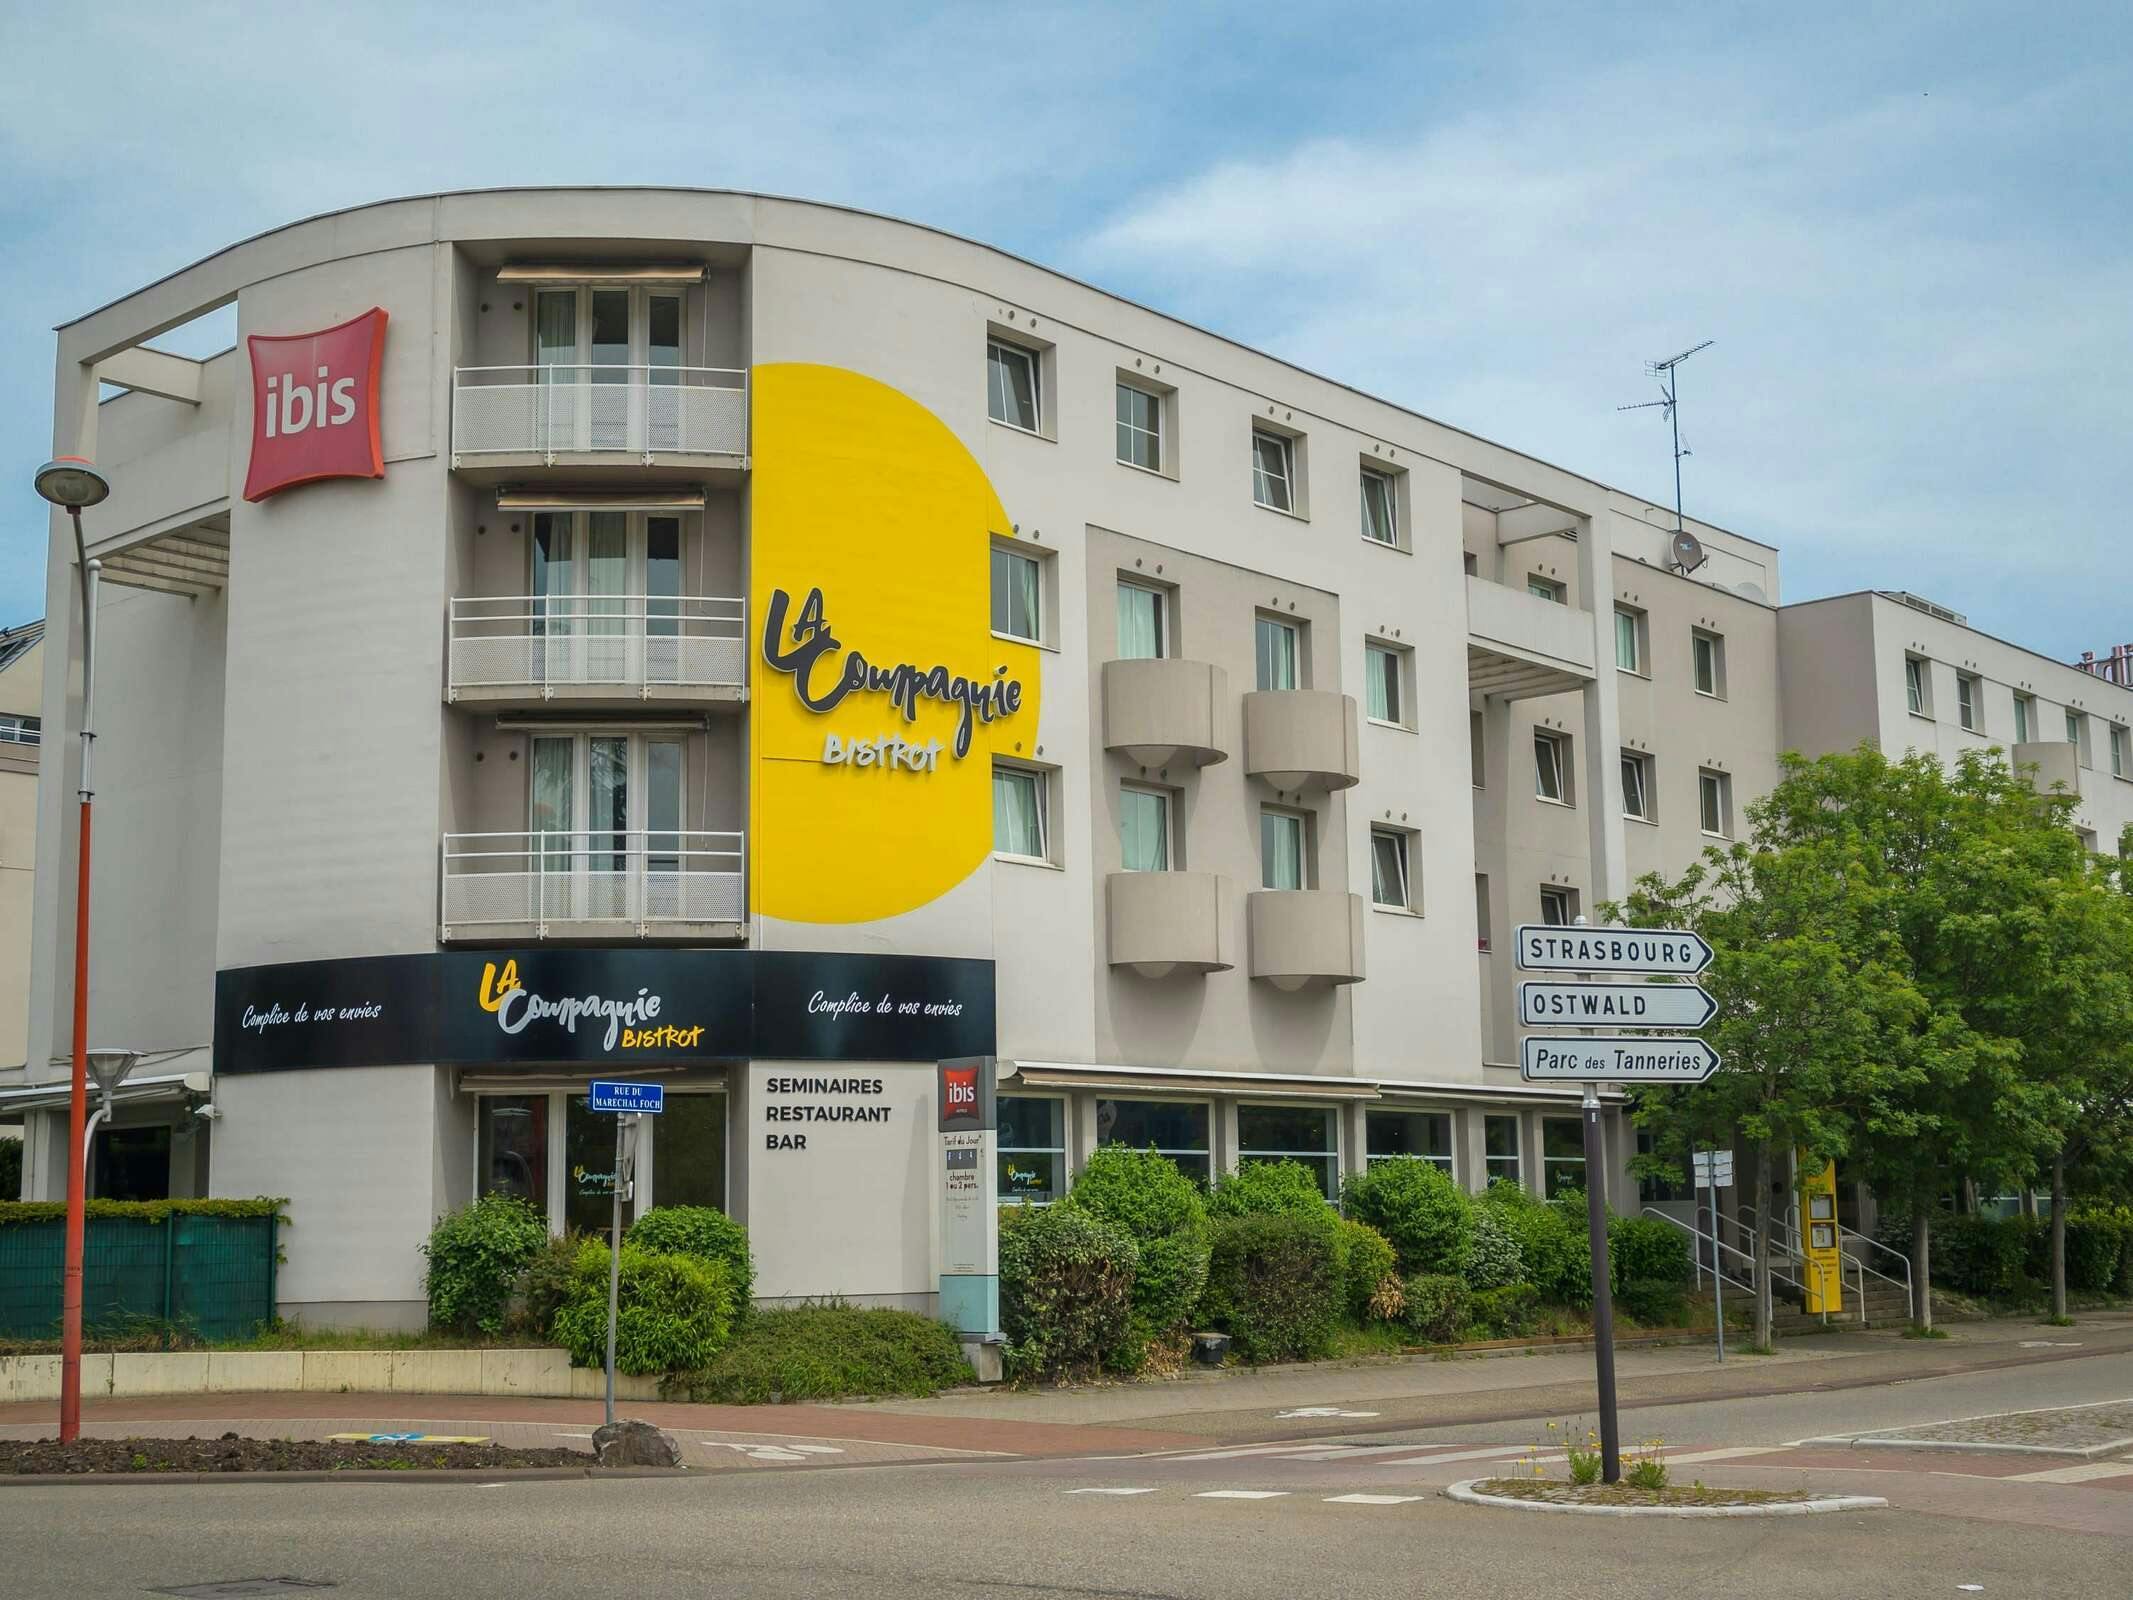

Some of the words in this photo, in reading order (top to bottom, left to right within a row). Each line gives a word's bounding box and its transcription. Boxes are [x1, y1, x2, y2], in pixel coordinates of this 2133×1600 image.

[266, 365, 356, 438] ibis
[763, 587, 834, 671] LA
[795, 634, 1022, 760] Compagnie
[1530, 938, 1691, 963] STRASBOURG
[479, 959, 521, 1012] LA
[808, 990, 870, 1021] Complice
[876, 993, 893, 1014] de
[898, 1002, 920, 1015] vos
[924, 1000, 963, 1016] envies
[1533, 994, 1646, 1015] OSTWALD
[242, 1002, 290, 1034] Complice
[294, 1002, 309, 1023] de
[314, 1007, 335, 1021] vos
[339, 1001, 382, 1020] envies
[497, 987, 661, 1052] Compagnie
[1536, 1049, 1578, 1069] Parc
[1585, 1056, 1605, 1069] des
[1614, 1050, 1701, 1070] Tanneries
[614, 1086, 630, 1096] RUE
[632, 1087, 643, 1096] DU
[766, 1078, 883, 1094] SEMINAIRES
[949, 1081, 975, 1103] ibis
[595, 1098, 638, 1108] MARECHAL
[640, 1100, 660, 1109] FOCH
[766, 1106, 892, 1122] RESTAURANT
[766, 1134, 806, 1150] BAR
